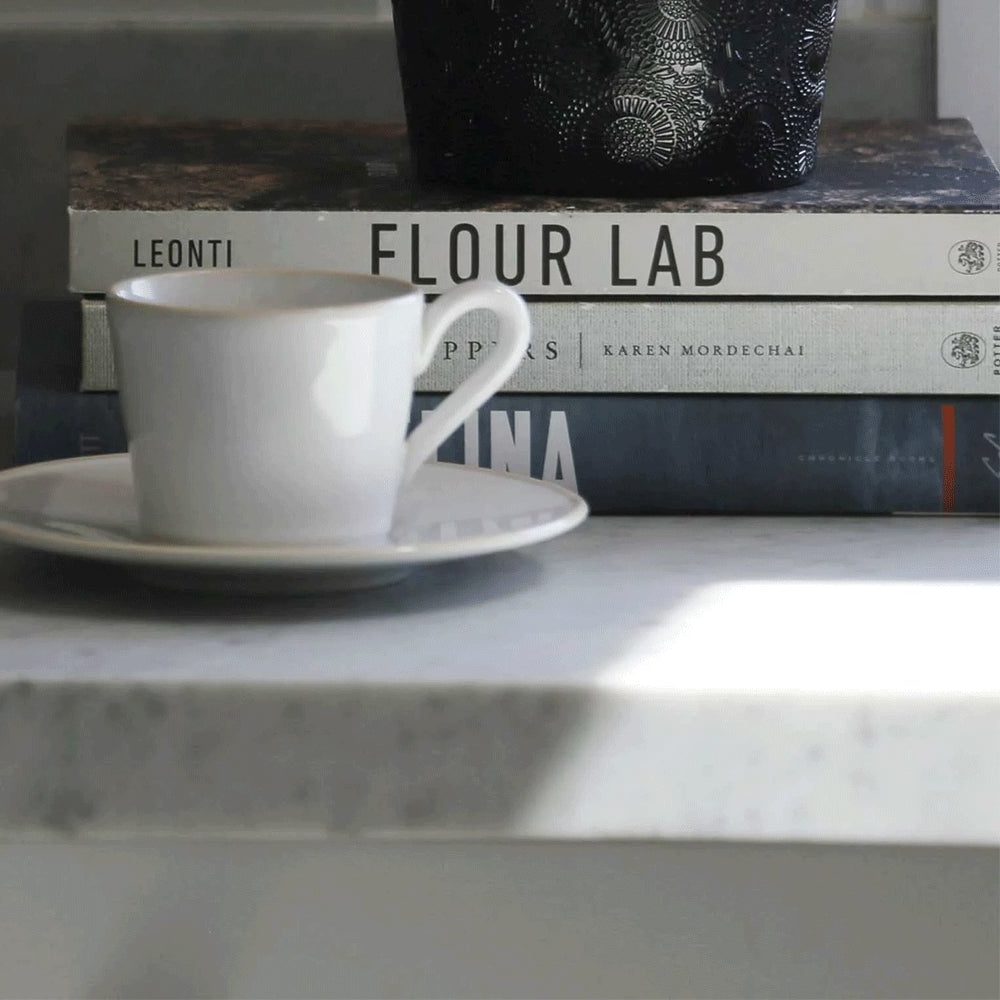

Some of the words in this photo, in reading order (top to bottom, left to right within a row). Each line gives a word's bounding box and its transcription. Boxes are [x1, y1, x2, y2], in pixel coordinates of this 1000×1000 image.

[134, 239, 232, 268] LEONTI
[371, 223, 572, 287] FLOUR
[611, 224, 725, 287] LAB
[604, 344, 670, 356] KAREN
[681, 344, 804, 356] MORDECHAI
